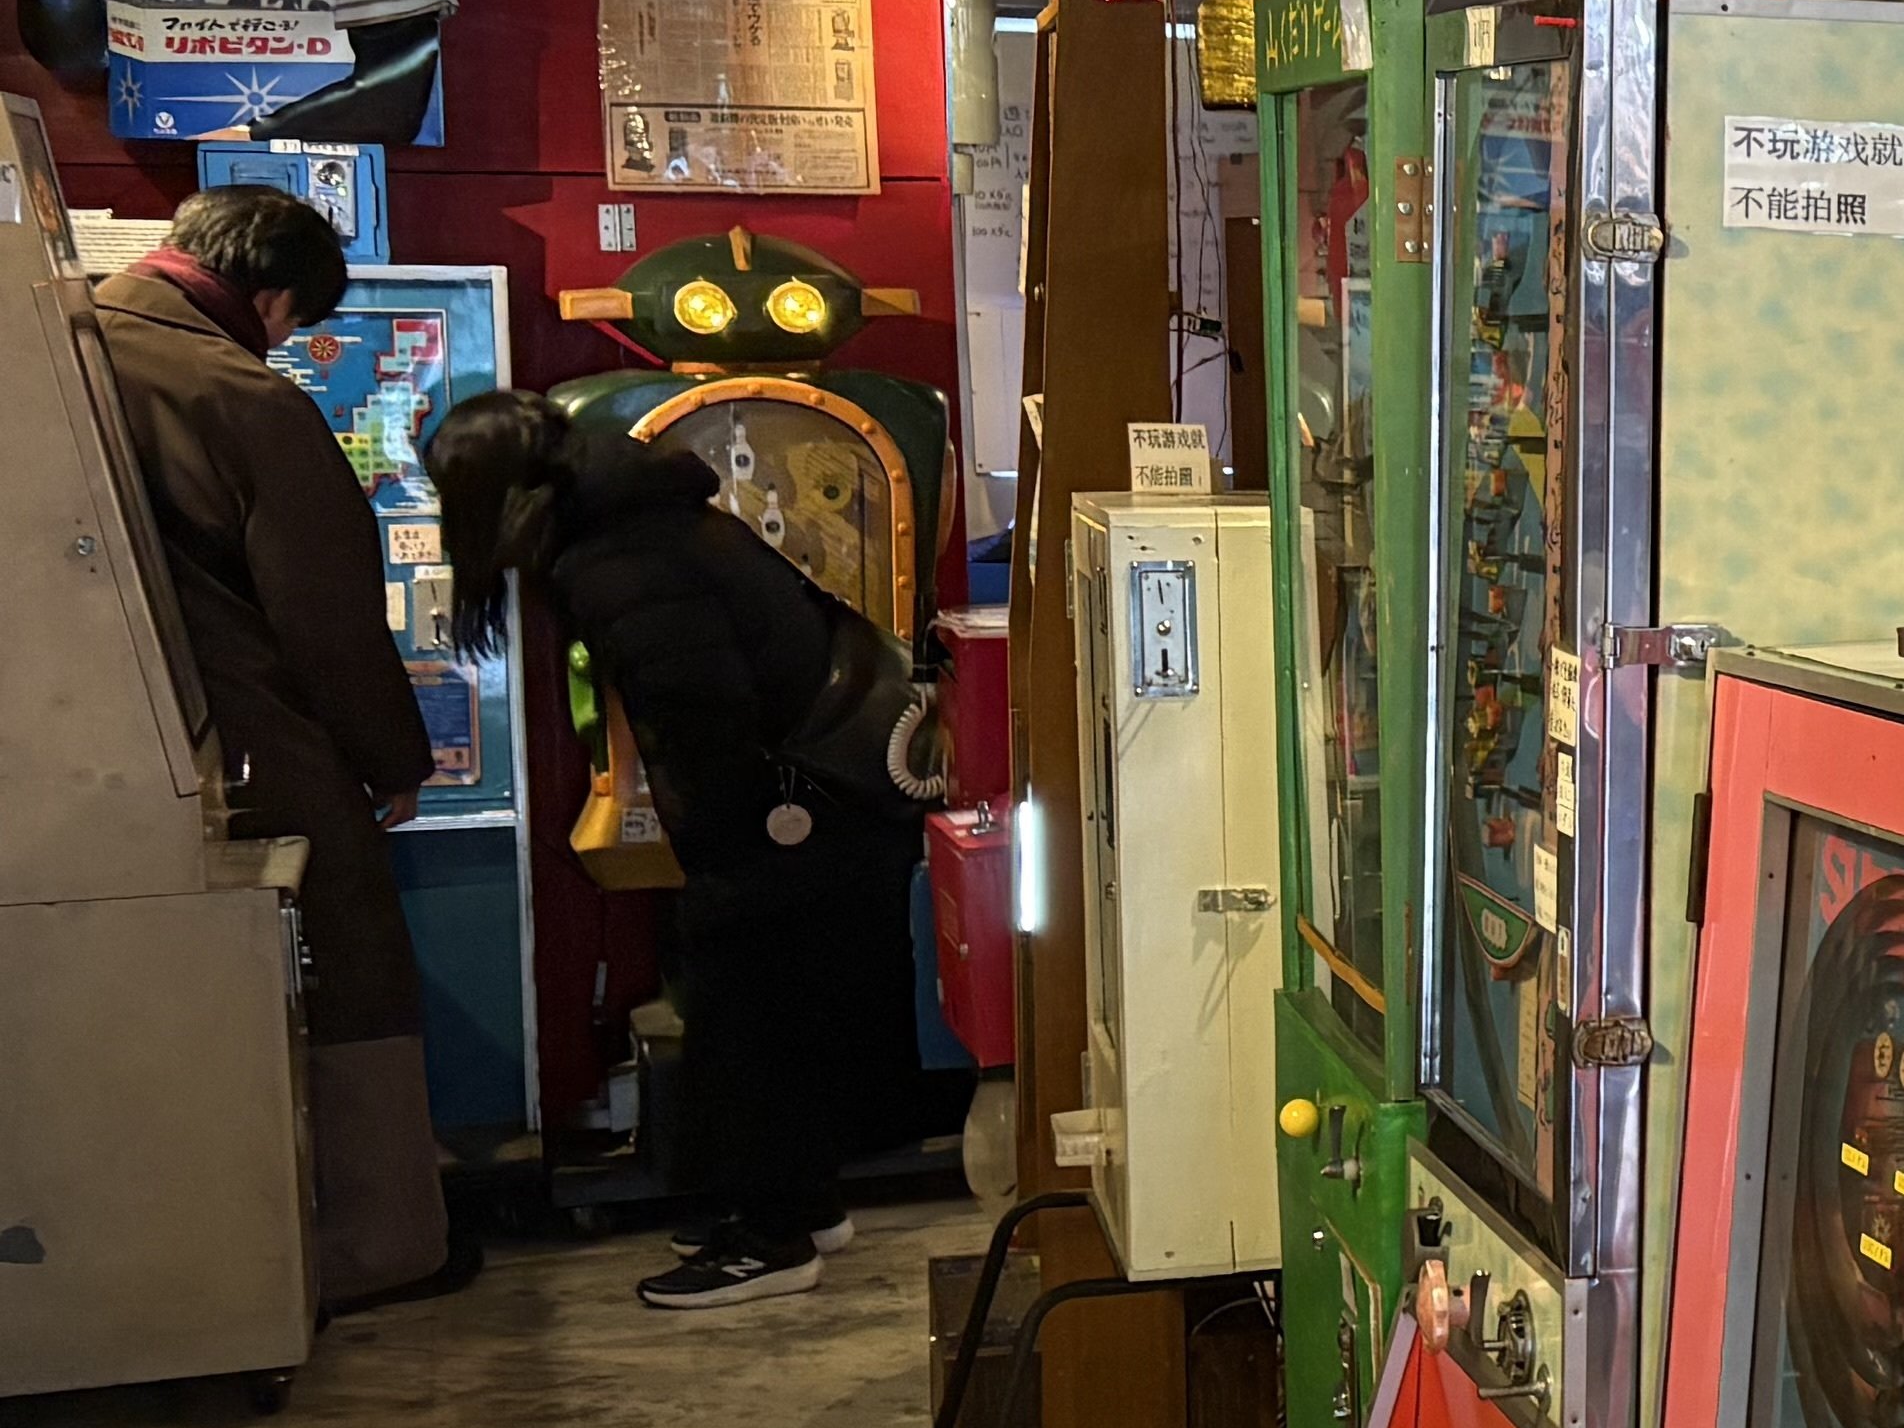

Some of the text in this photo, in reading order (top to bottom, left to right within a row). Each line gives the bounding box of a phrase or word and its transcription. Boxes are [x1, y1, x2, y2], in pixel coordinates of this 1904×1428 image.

[1733, 126, 1904, 166] 不玩游戏就
[1730, 186, 1867, 225] 不能拍照
